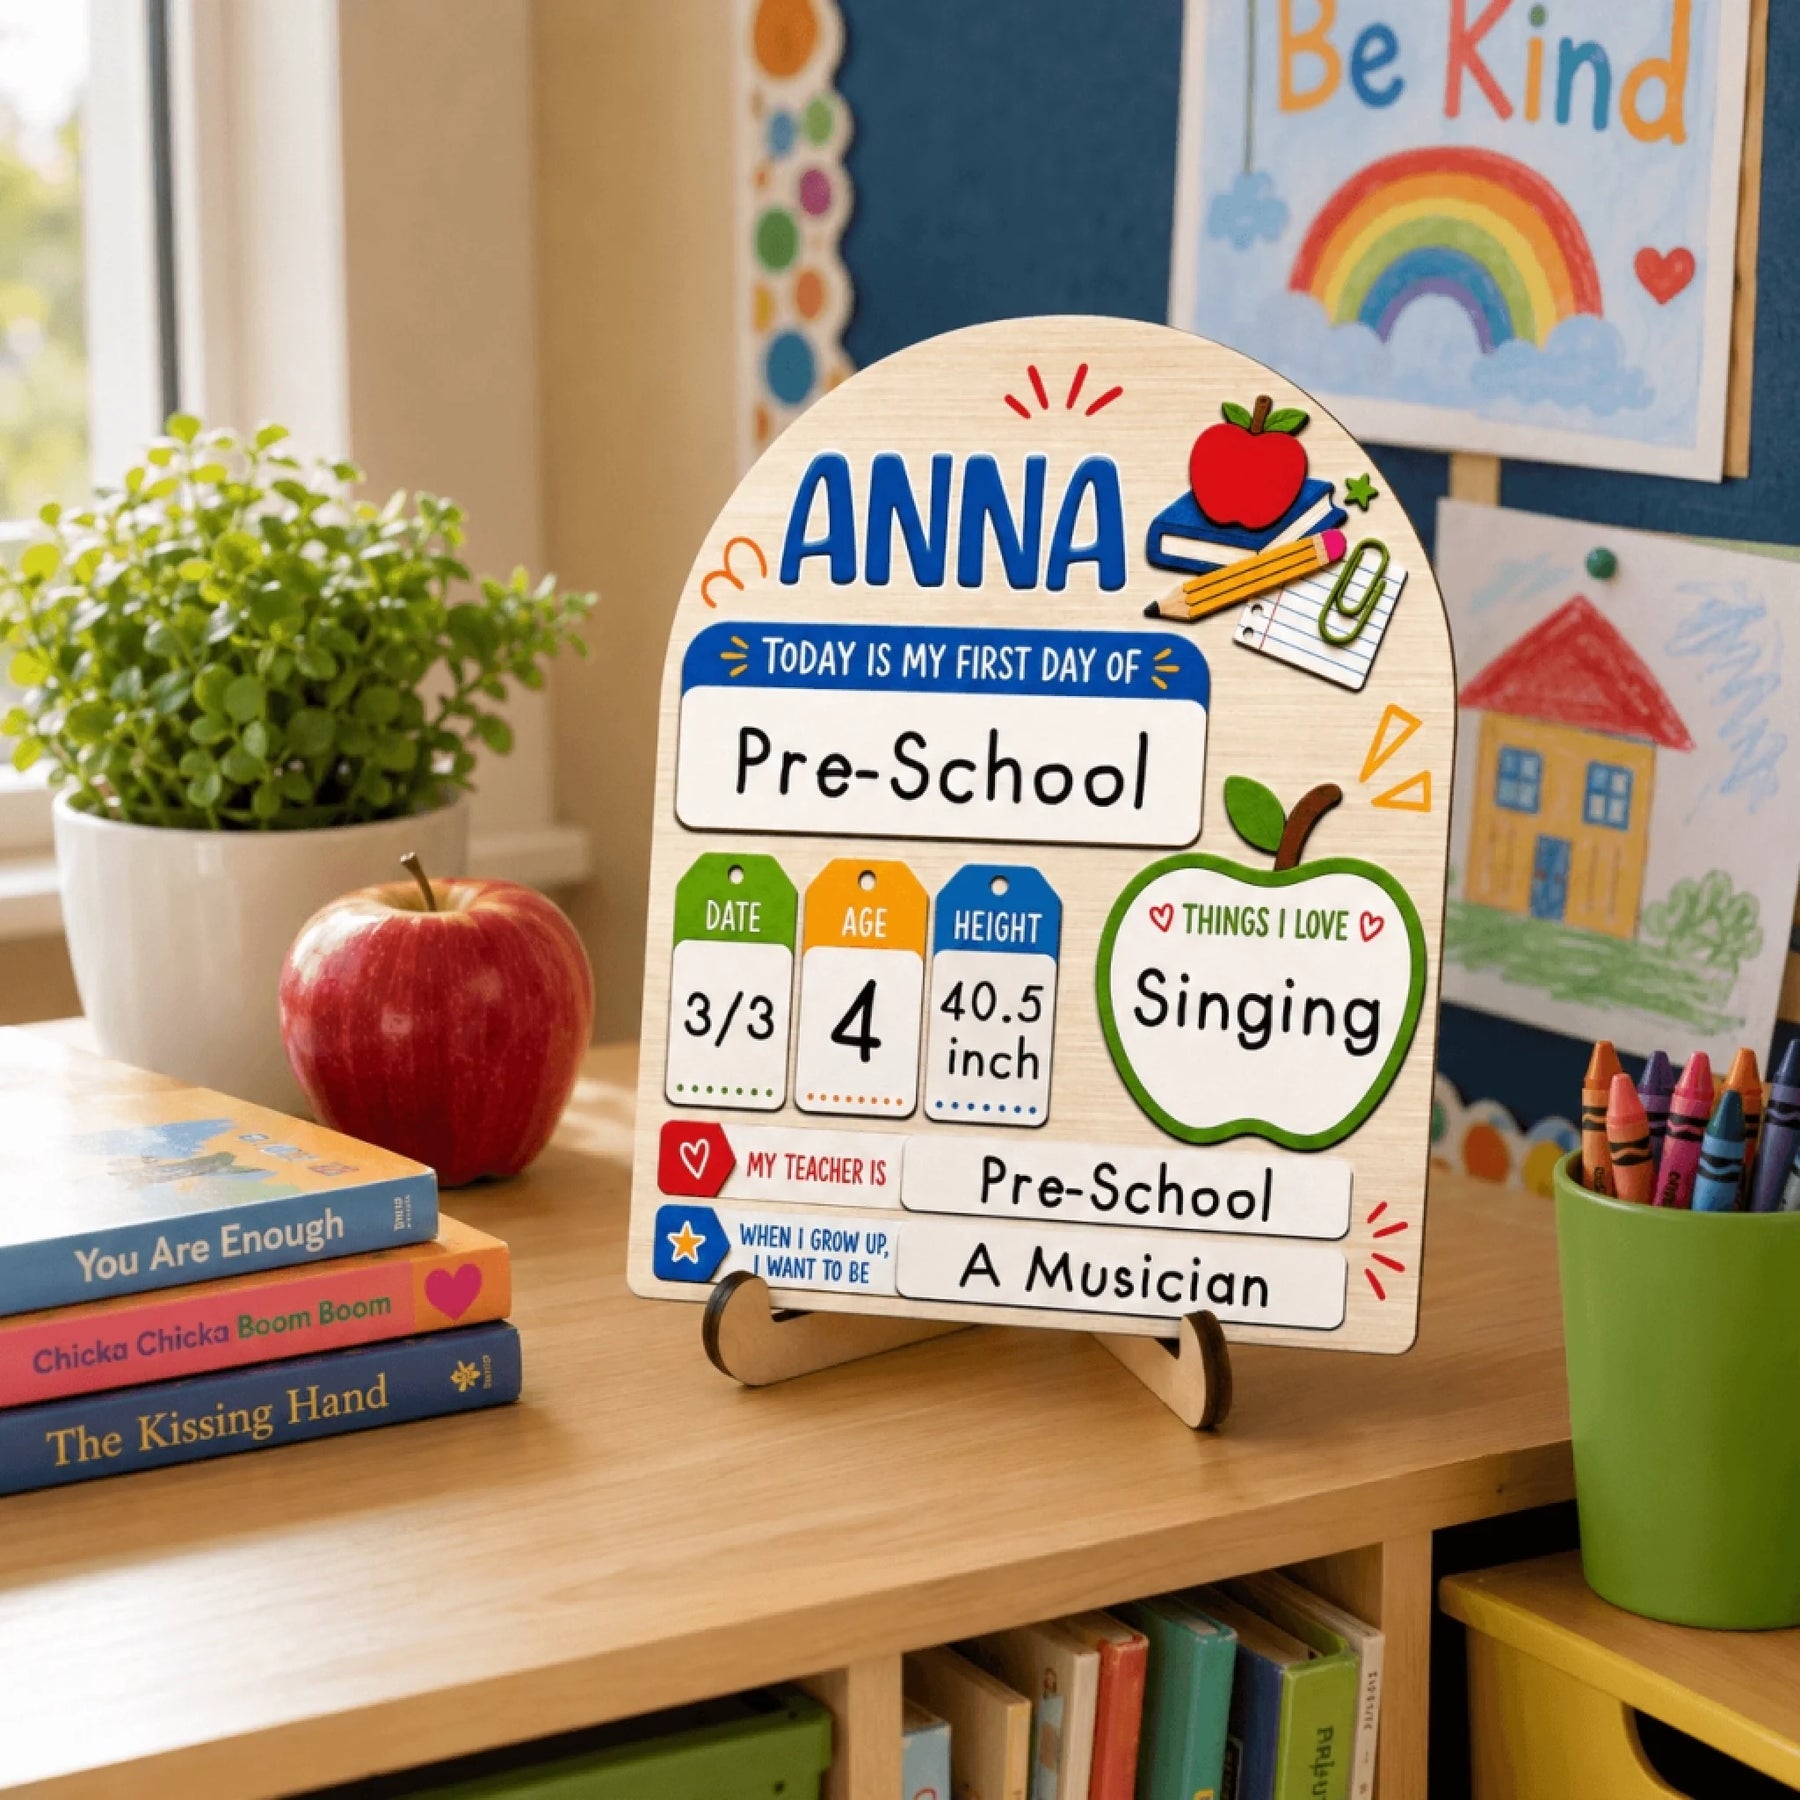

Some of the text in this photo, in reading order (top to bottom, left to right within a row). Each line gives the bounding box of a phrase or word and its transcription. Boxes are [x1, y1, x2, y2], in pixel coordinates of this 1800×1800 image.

[1277, 0, 1691, 146] Be Kind
[779, 451, 1127, 592] ANNA
[762, 636, 1142, 684] TODAY IS MY FIRST DAY OF
[736, 727, 1149, 809] Pre-School
[705, 900, 761, 934] DATE
[842, 907, 888, 938] AGE
[954, 910, 1043, 943] HEIGHT
[1183, 902, 1350, 941] THINGS I LOVE
[684, 990, 775, 1047] 3/3
[830, 978, 882, 1063] 4
[940, 980, 1044, 1024] 40.5
[1134, 967, 1381, 1056] Singing
[947, 1035, 1039, 1080] inch
[746, 1152, 887, 1186] MY TEACHER IS
[981, 1155, 1273, 1222] Pre-School
[75, 1208, 345, 1283] You Are Enough
[739, 1223, 890, 1259] WHEN I GROW UP,
[754, 1254, 870, 1285] I WANT TO BE
[959, 1242, 1269, 1308] A Musician
[33, 1296, 392, 1375] Chicka Chicka Boom Boom
[46, 1373, 389, 1468] The Kissing Hand
